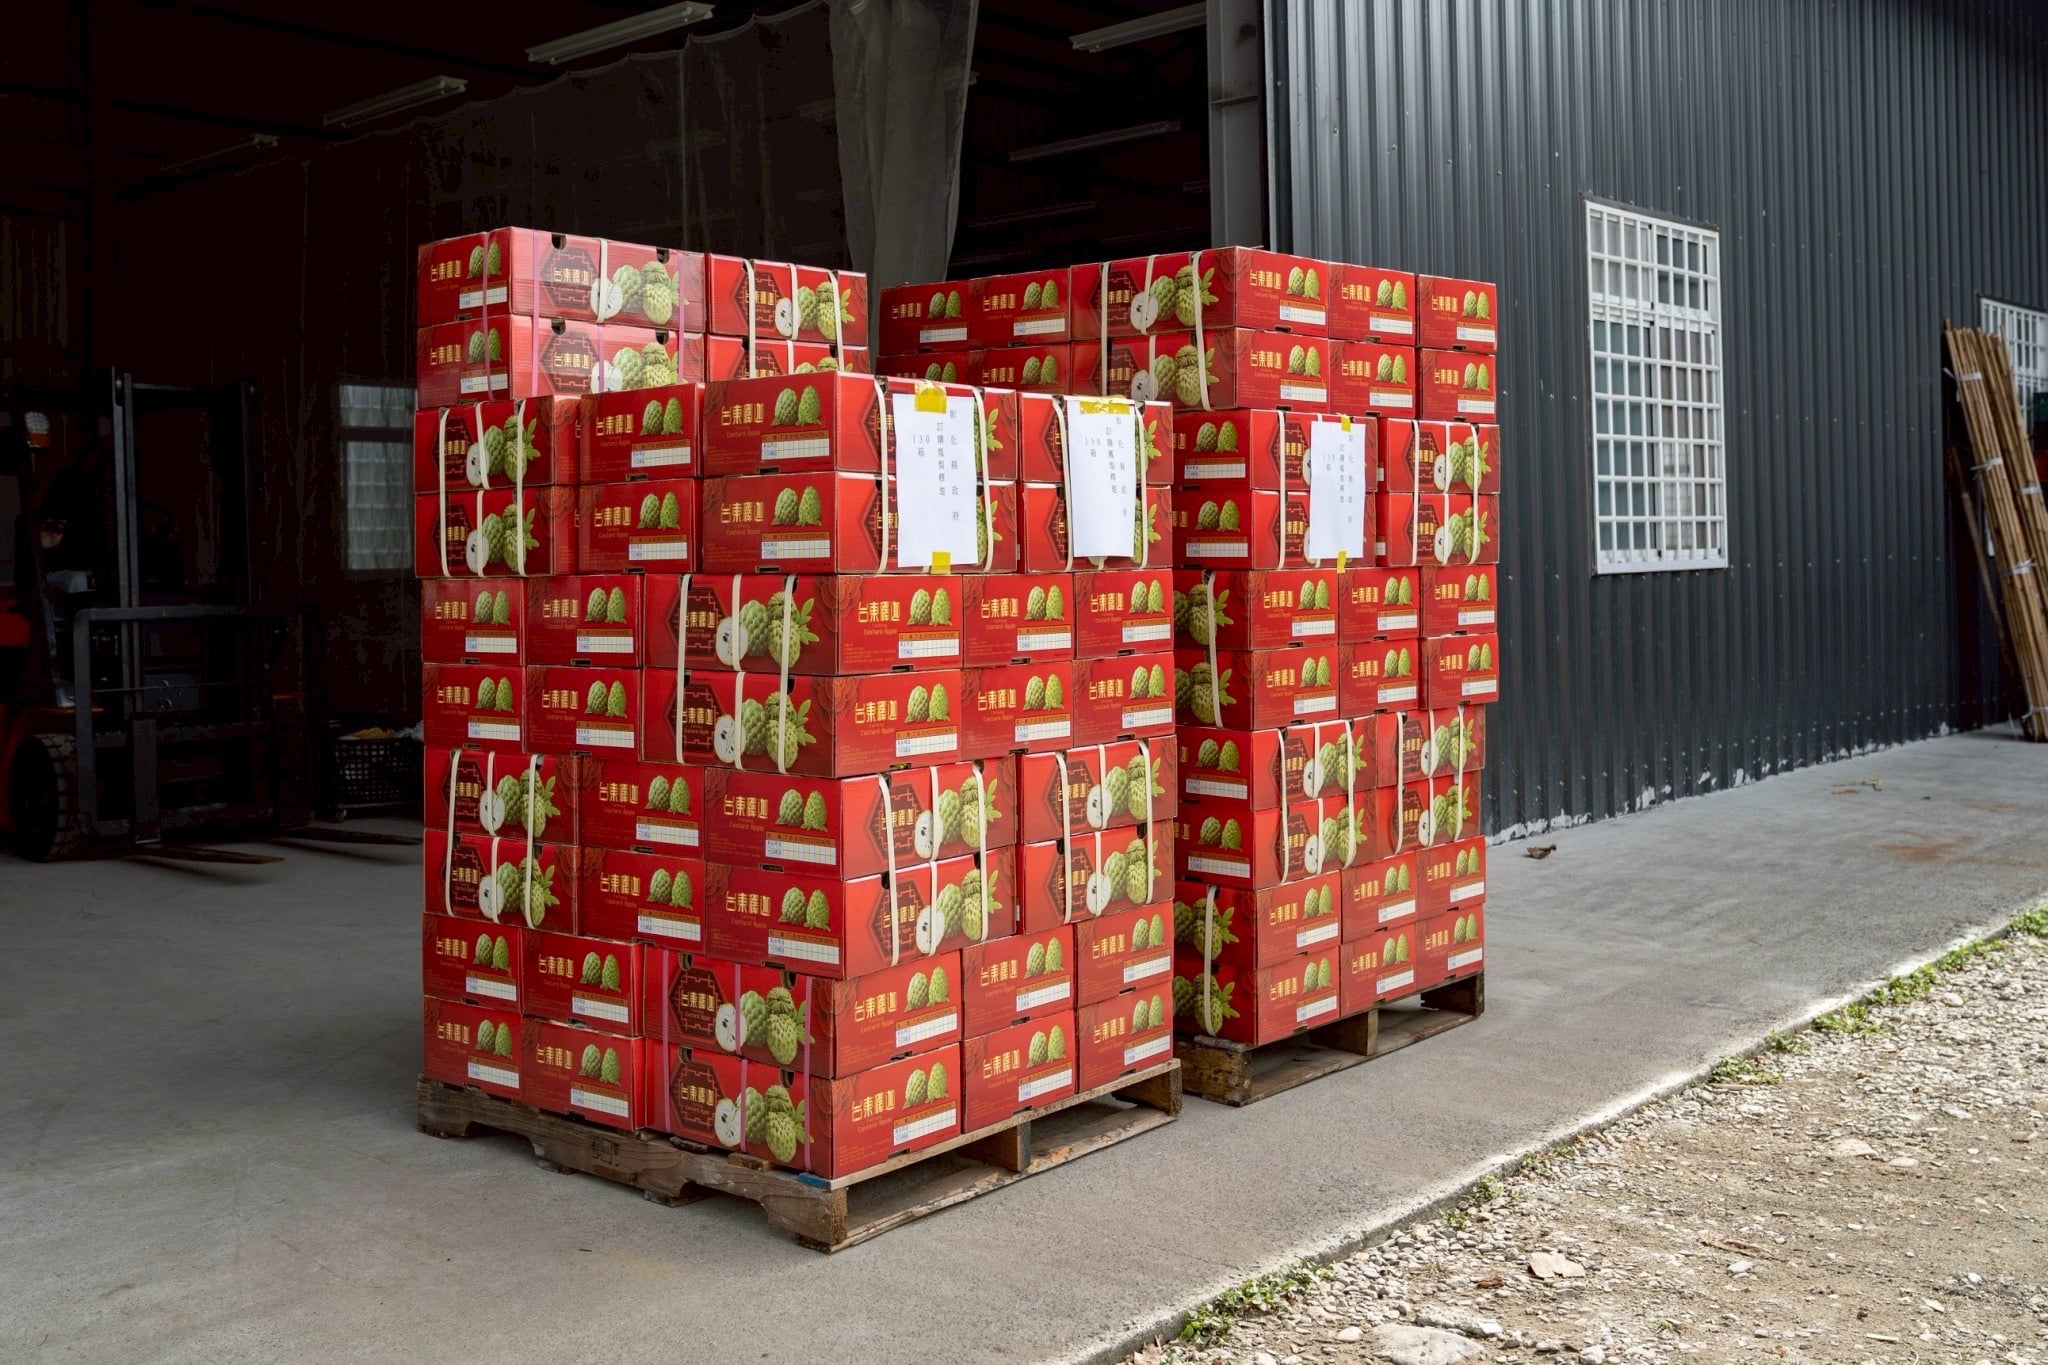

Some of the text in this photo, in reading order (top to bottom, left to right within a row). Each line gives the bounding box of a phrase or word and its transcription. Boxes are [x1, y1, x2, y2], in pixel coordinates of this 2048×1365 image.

[430, 260, 461, 282] 台東釋迦
[553, 268, 589, 285] 台東釋迦
[1250, 270, 1281, 289] 台東釋迦
[983, 293, 1016, 311] 台東釋迦
[1341, 283, 1371, 302] 台東釋迦
[430, 344, 461, 365] 台東釋迦
[553, 355, 589, 369] 台東釋迦
[1250, 351, 1282, 369] 台東釋迦
[1341, 360, 1371, 377] 台東釋迦
[721, 402, 764, 426] 台東釋迦
[596, 414, 634, 437] 台東釋迦
[594, 506, 631, 528] 台東釋迦
[721, 501, 764, 523] 台東釋迦
[1090, 593, 1124, 613] 台東釋迦
[1264, 590, 1294, 608] 台東釋迦
[1352, 586, 1379, 604] 台東釋迦
[436, 601, 468, 619] 台東釋迦
[543, 599, 578, 618] 台東釋迦
[858, 600, 900, 623] 台東釋迦
[981, 597, 1019, 618] 台東釋迦
[1267, 668, 1296, 688] 台東釋迦
[1352, 660, 1379, 678] 台東釋迦
[437, 685, 470, 704] 台東釋迦
[542, 690, 578, 709] 台東釋迦
[978, 688, 1017, 711] 台東釋迦
[1089, 678, 1123, 700] 台東釋迦
[855, 700, 898, 724] 台東釋迦
[600, 782, 639, 804] 台東釋迦
[724, 794, 768, 819] 台東釋迦
[600, 872, 640, 896] 台東釋迦
[1354, 879, 1379, 901] 台東釋迦
[726, 890, 771, 916] 台東釋迦
[1270, 902, 1298, 926] 台東釋迦
[436, 936, 468, 959] 台東釋迦
[1092, 933, 1125, 959] 台東釋迦
[539, 954, 574, 978] 台東釋迦
[981, 959, 1018, 987] 台東釋迦
[1352, 951, 1378, 974] 台東釋迦
[1270, 977, 1297, 1000] 台東釋迦
[681, 991, 715, 1012] 台東釋迦
[855, 991, 897, 1022] 台東釋迦
[437, 1021, 470, 1044] 台東釋迦
[1094, 1016, 1125, 1044] 台東釋迦
[537, 1043, 573, 1069] 台東釋迦
[984, 1049, 1020, 1079] 台東釋迦
[681, 1082, 714, 1106] 台東釋迦
[852, 1089, 895, 1121] 台東釋迦
